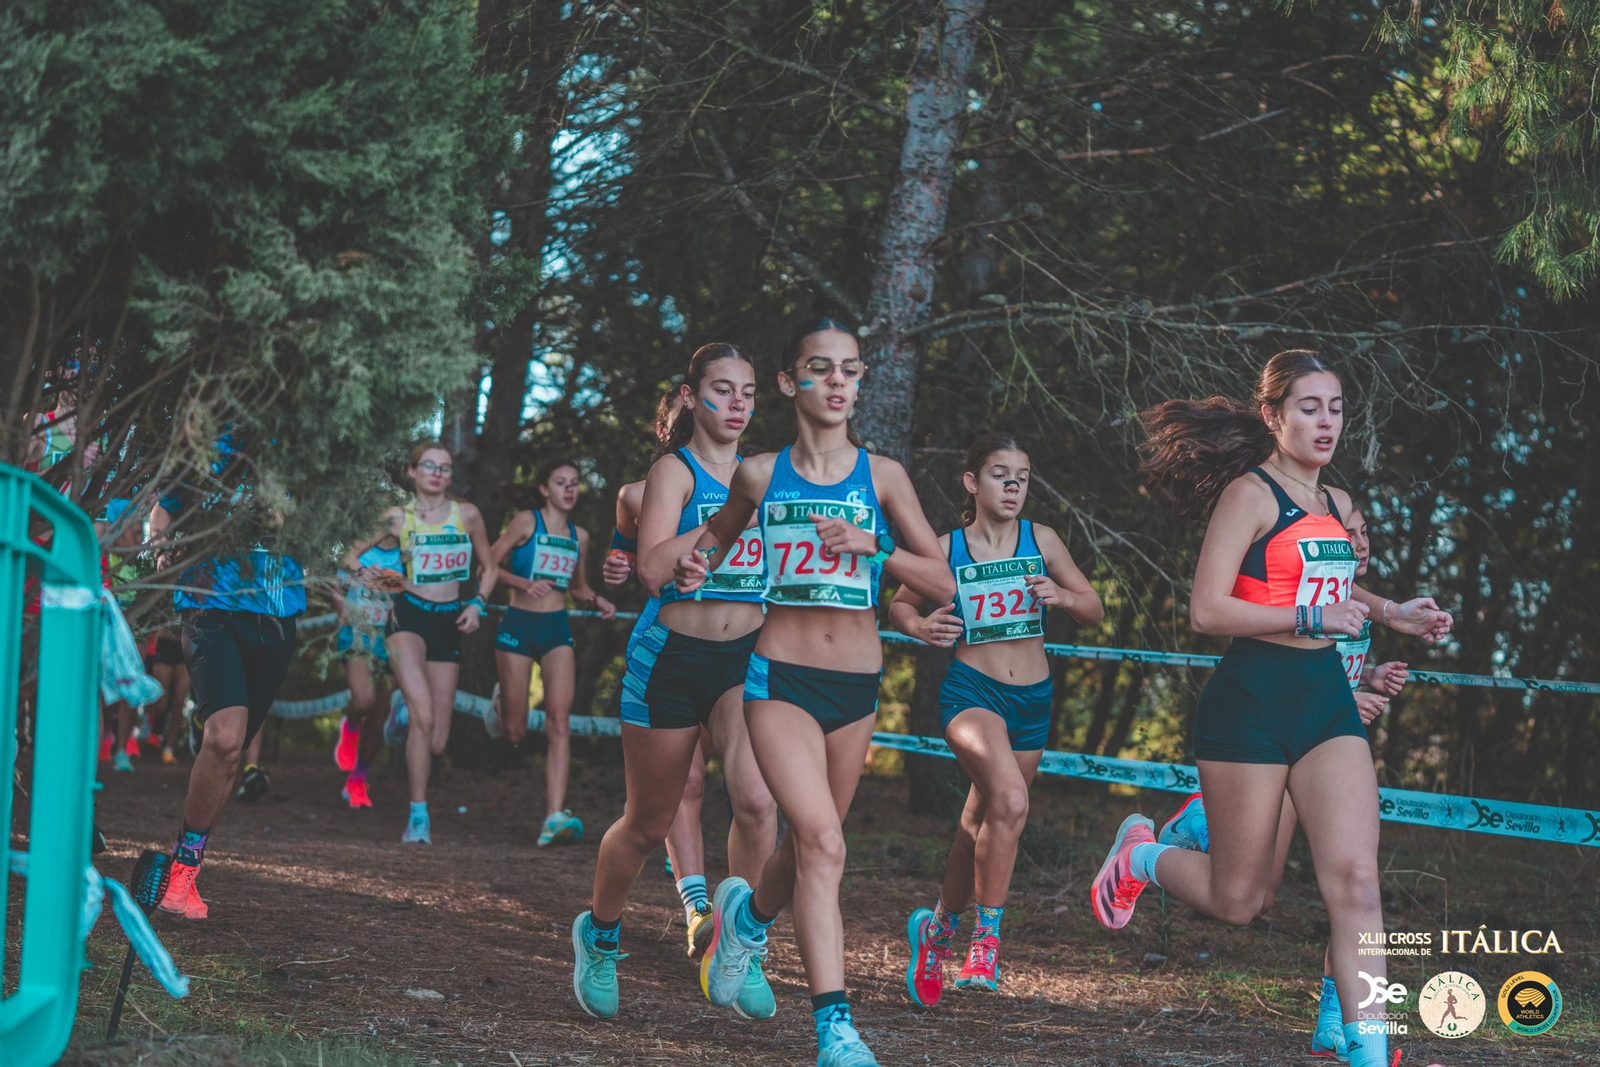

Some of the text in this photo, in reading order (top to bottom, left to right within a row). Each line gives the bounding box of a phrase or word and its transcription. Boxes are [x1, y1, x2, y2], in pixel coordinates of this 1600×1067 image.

[702, 492, 728, 500] vive
[774, 490, 800, 499] vive
[793, 503, 847, 519] ITÁLICA
[729, 537, 762, 567] 29
[1322, 541, 1352, 555] ITÁLICA
[420, 552, 467, 570] 7360
[982, 561, 1024, 575] ITÁLICA
[1307, 576, 1355, 607] 731
[1396, 806, 1430, 821] Sevilla
[1505, 810, 1541, 822] Diputación
[1504, 819, 1541, 834] Sevilla
